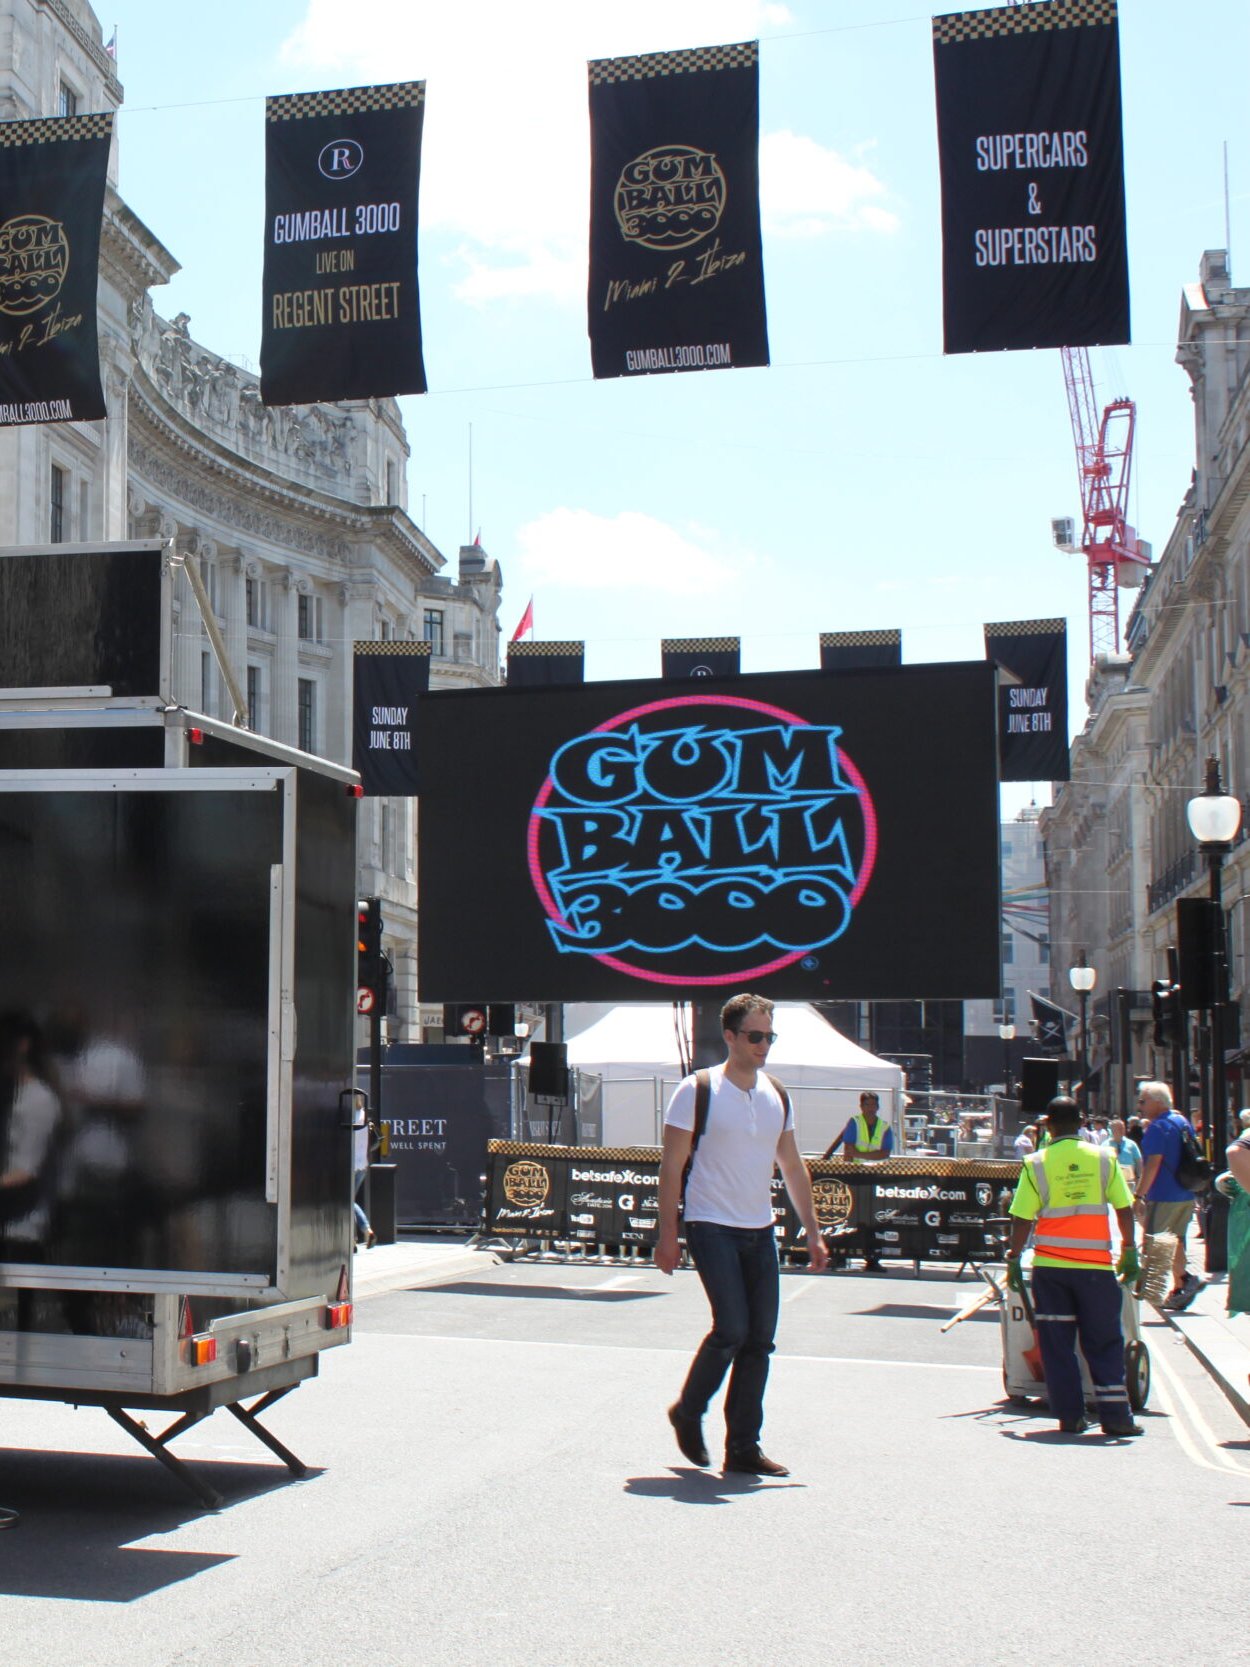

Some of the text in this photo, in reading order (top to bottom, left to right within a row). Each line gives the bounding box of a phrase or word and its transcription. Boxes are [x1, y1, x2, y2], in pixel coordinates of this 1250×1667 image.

[976, 130, 1088, 171] SUPERCARS
[621, 180, 718, 216] BALL
[1028, 182, 1042, 215] &
[274, 202, 400, 244] GUMBALL 3000
[975, 225, 1097, 267] SUPERSTARS
[316, 250, 355, 274] LIVE ON
[273, 282, 400, 330] REGENT STREET
[626, 343, 731, 372] GUMBALL3000.COM
[1010, 687, 1048, 708] SUNDAY
[372, 706, 408, 725] SUNDAY
[1007, 712, 1051, 733] JUNE 8TH
[369, 731, 411, 750] JUNE 8TH
[533, 797, 855, 884] BALL
[381, 1119, 447, 1136] TREET
[390, 1142, 447, 1150] WELL SPENT
